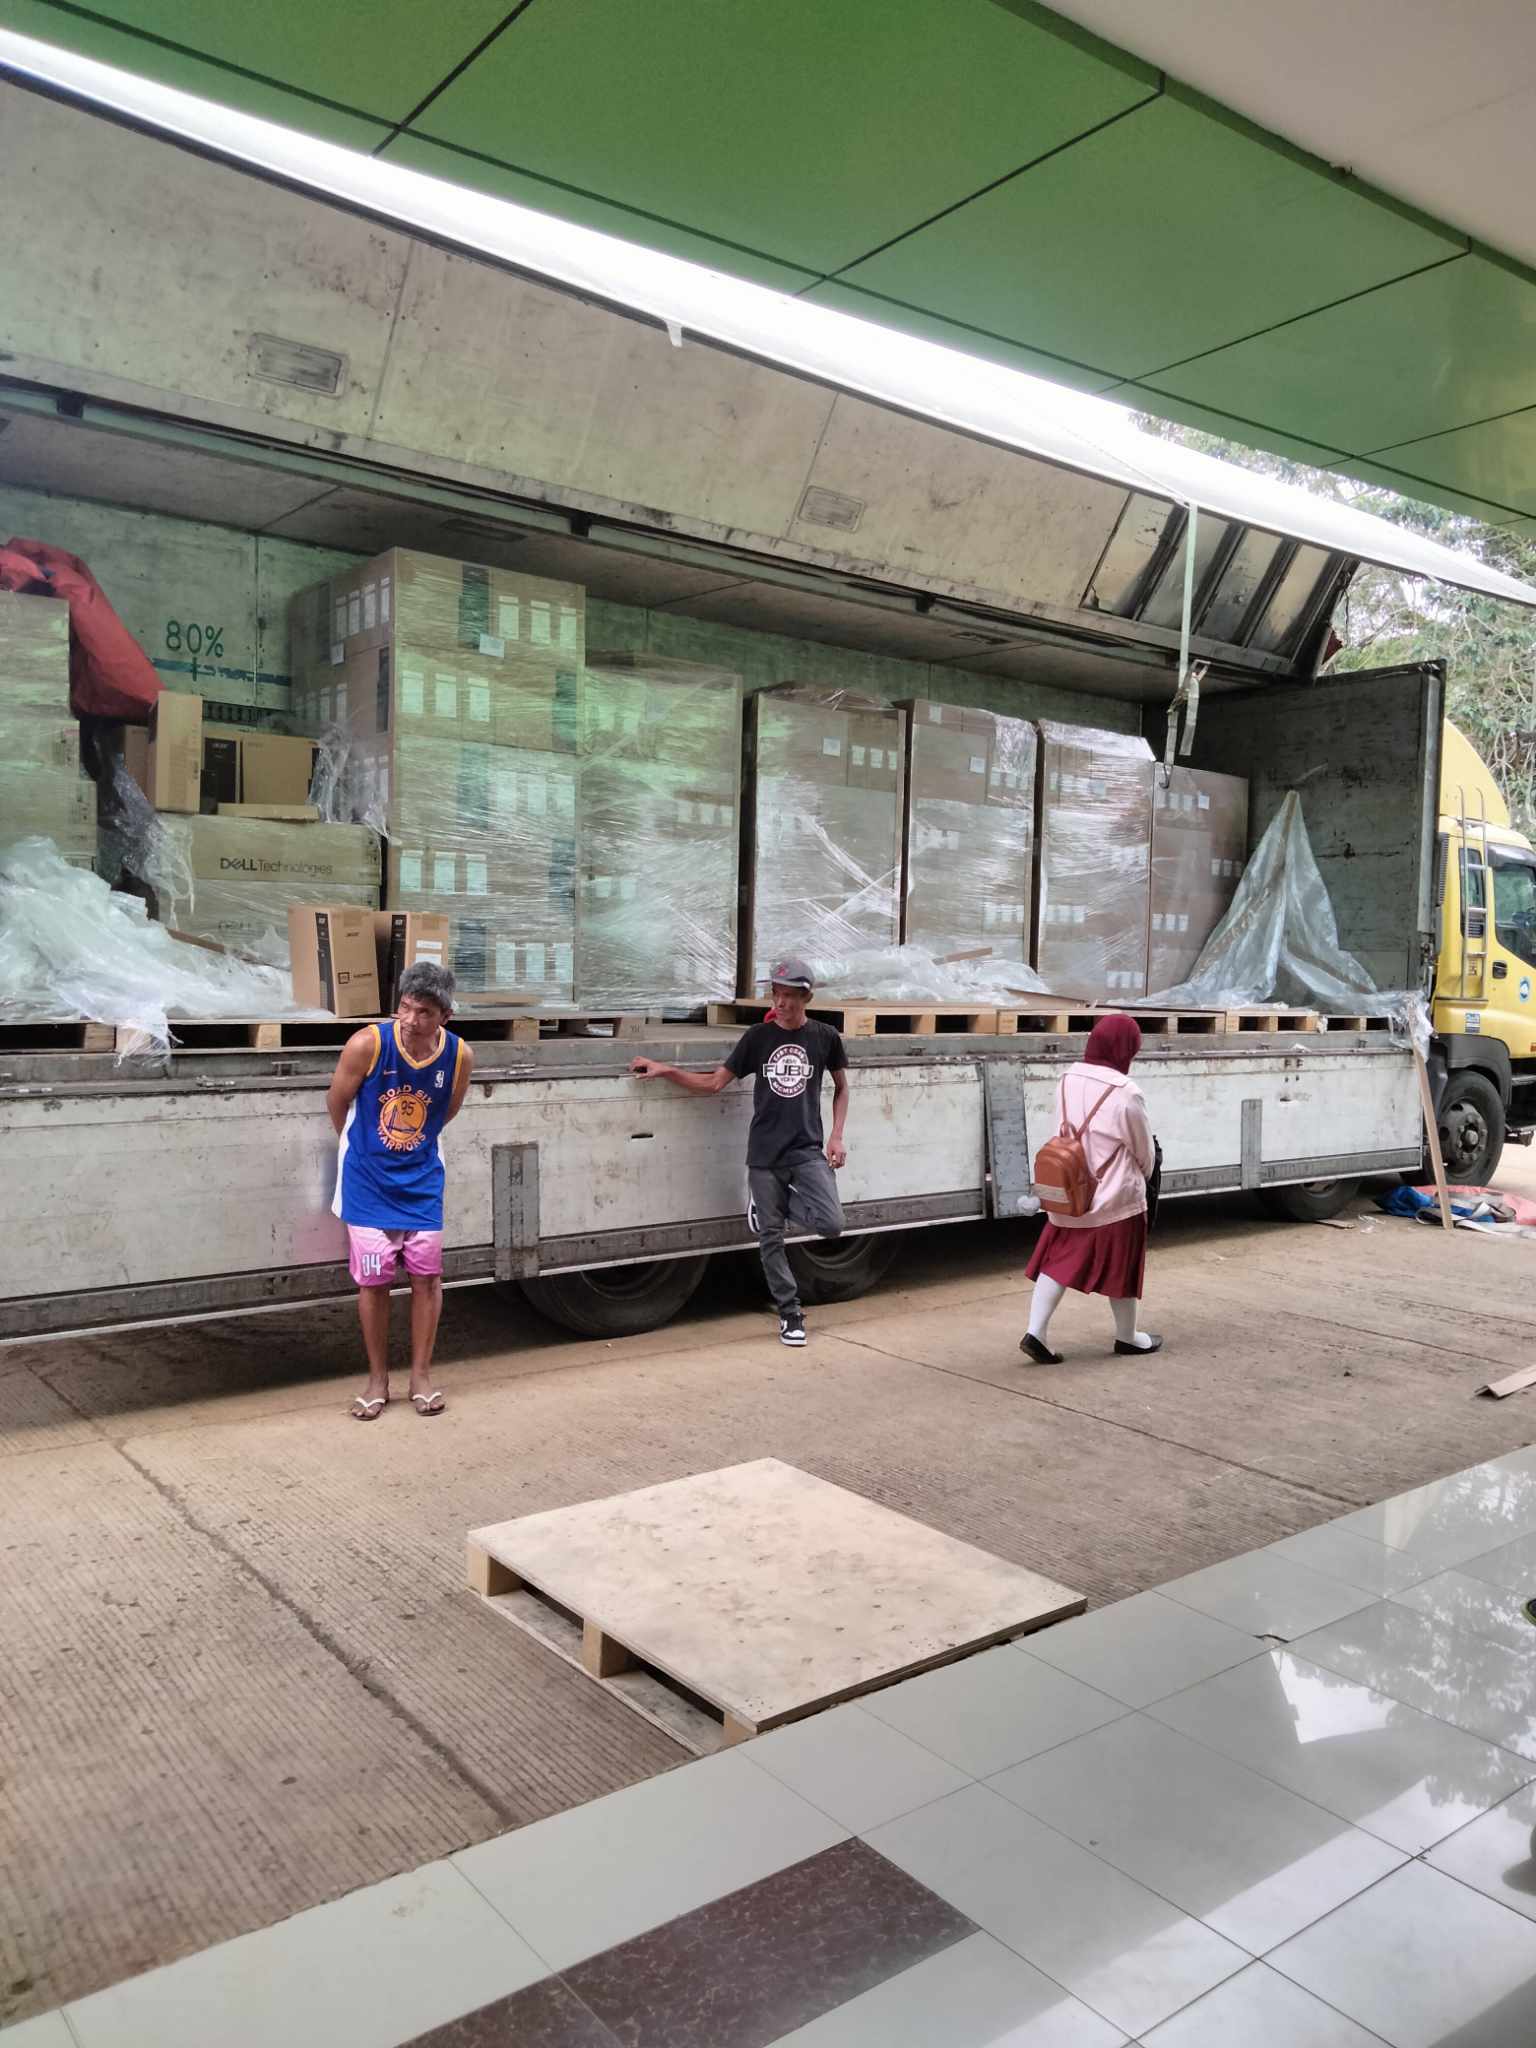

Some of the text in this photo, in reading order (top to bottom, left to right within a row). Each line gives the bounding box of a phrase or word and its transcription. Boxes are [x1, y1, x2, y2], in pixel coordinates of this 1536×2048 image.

[166, 620, 224, 657] 80%
[220, 858, 333, 877] DELL Technologies
[763, 1064, 814, 1079] FUBU
[378, 1084, 433, 1106] ROAD SIX
[401, 1100, 416, 1116] 95
[377, 1126, 426, 1152] WARRIORS
[362, 1253, 381, 1277] 04
